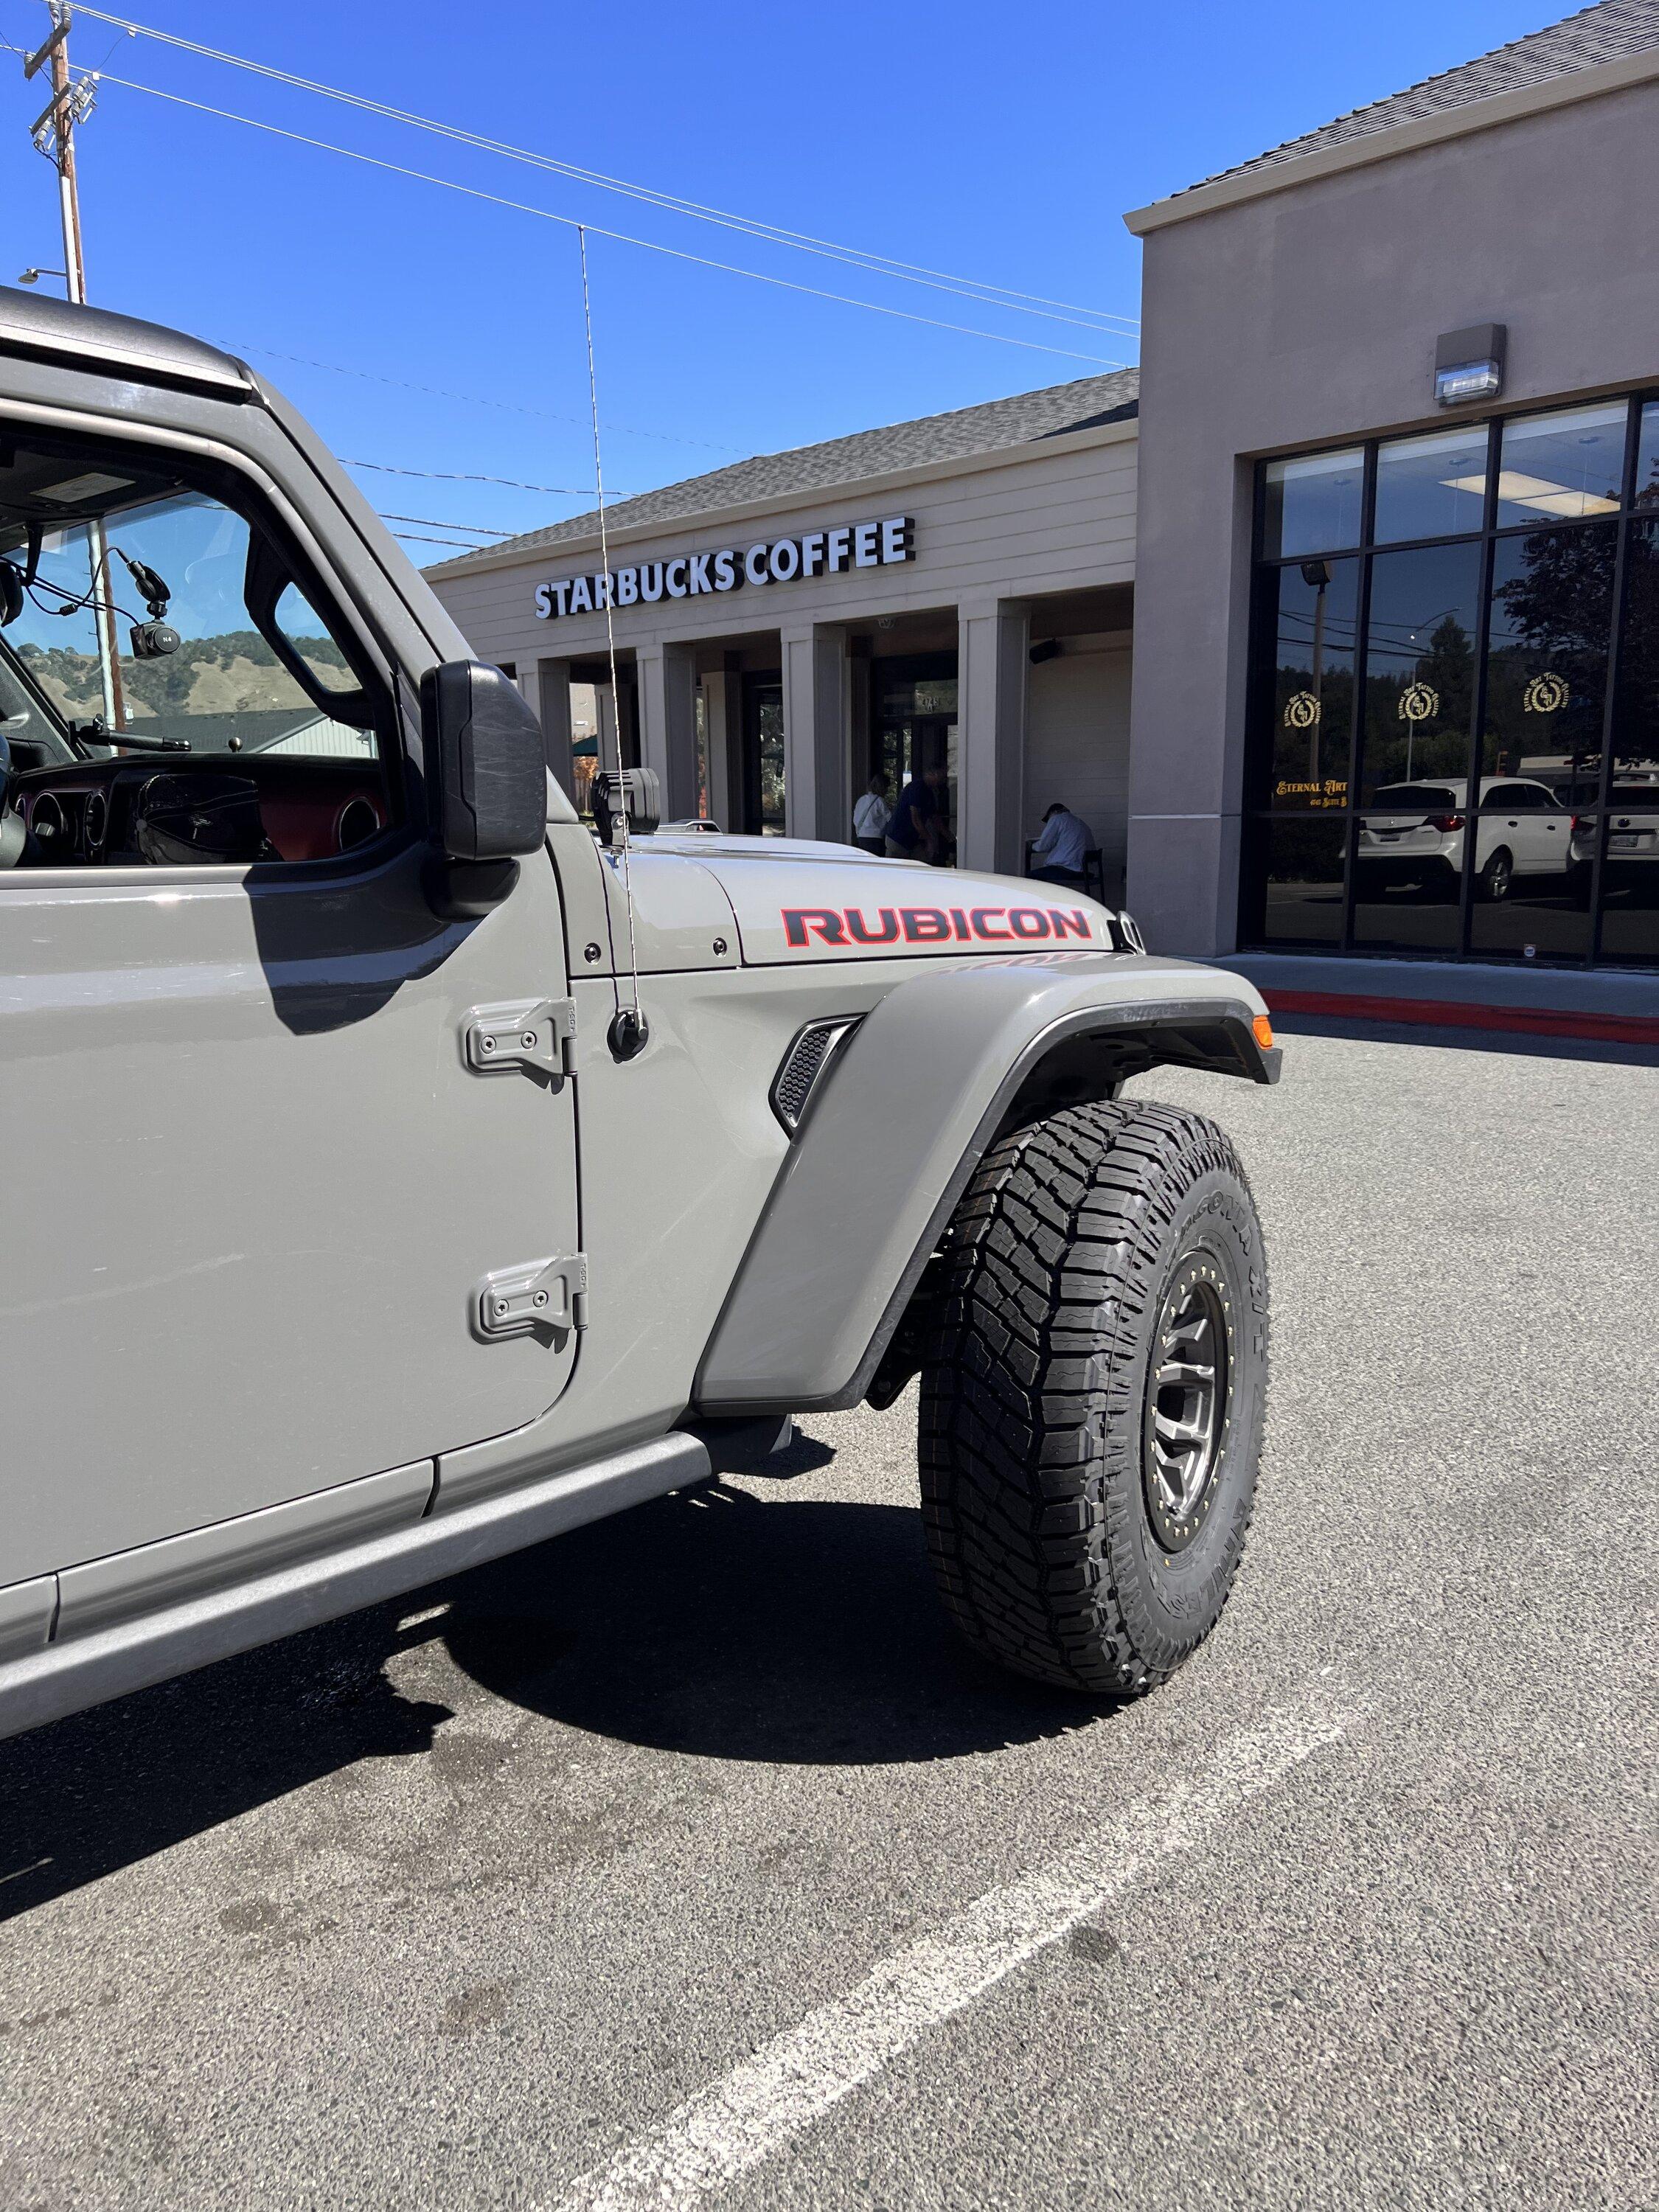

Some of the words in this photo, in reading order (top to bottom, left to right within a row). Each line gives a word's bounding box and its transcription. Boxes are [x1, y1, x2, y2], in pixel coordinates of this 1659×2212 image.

[534, 550, 740, 619] STARBUCKS
[745, 517, 911, 585] COFFEE
[1276, 780, 1321, 796] ETERNAL
[1324, 779, 1349, 796] ART
[780, 908, 1093, 947] RUBICON
